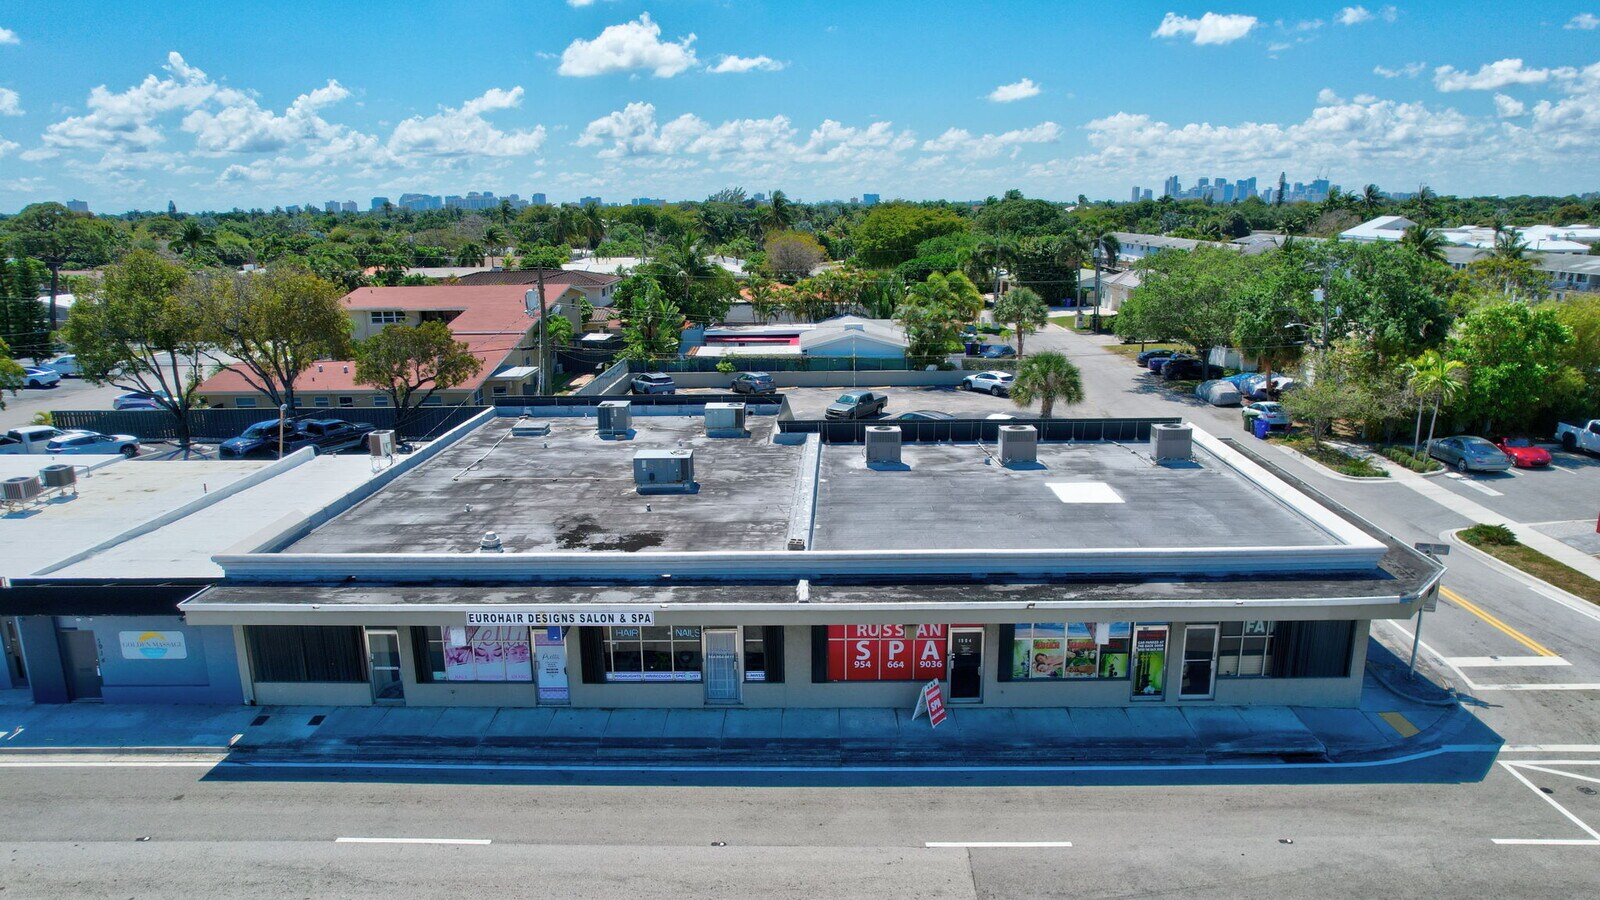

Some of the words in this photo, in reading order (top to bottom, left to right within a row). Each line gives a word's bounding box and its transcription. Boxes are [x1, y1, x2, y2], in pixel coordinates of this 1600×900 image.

[469, 613, 524, 623] EUROHAIR
[528, 613, 575, 623] DESIGNS
[579, 613, 615, 623] SALON
[619, 613, 627, 623] &
[631, 613, 651, 623] SPA
[615, 628, 639, 637] HAIR
[675, 628, 700, 638] NAILS
[857, 624, 941, 637] RUSSAN
[919, 660, 943, 668] 9036
[930, 698, 942, 712] SPA
